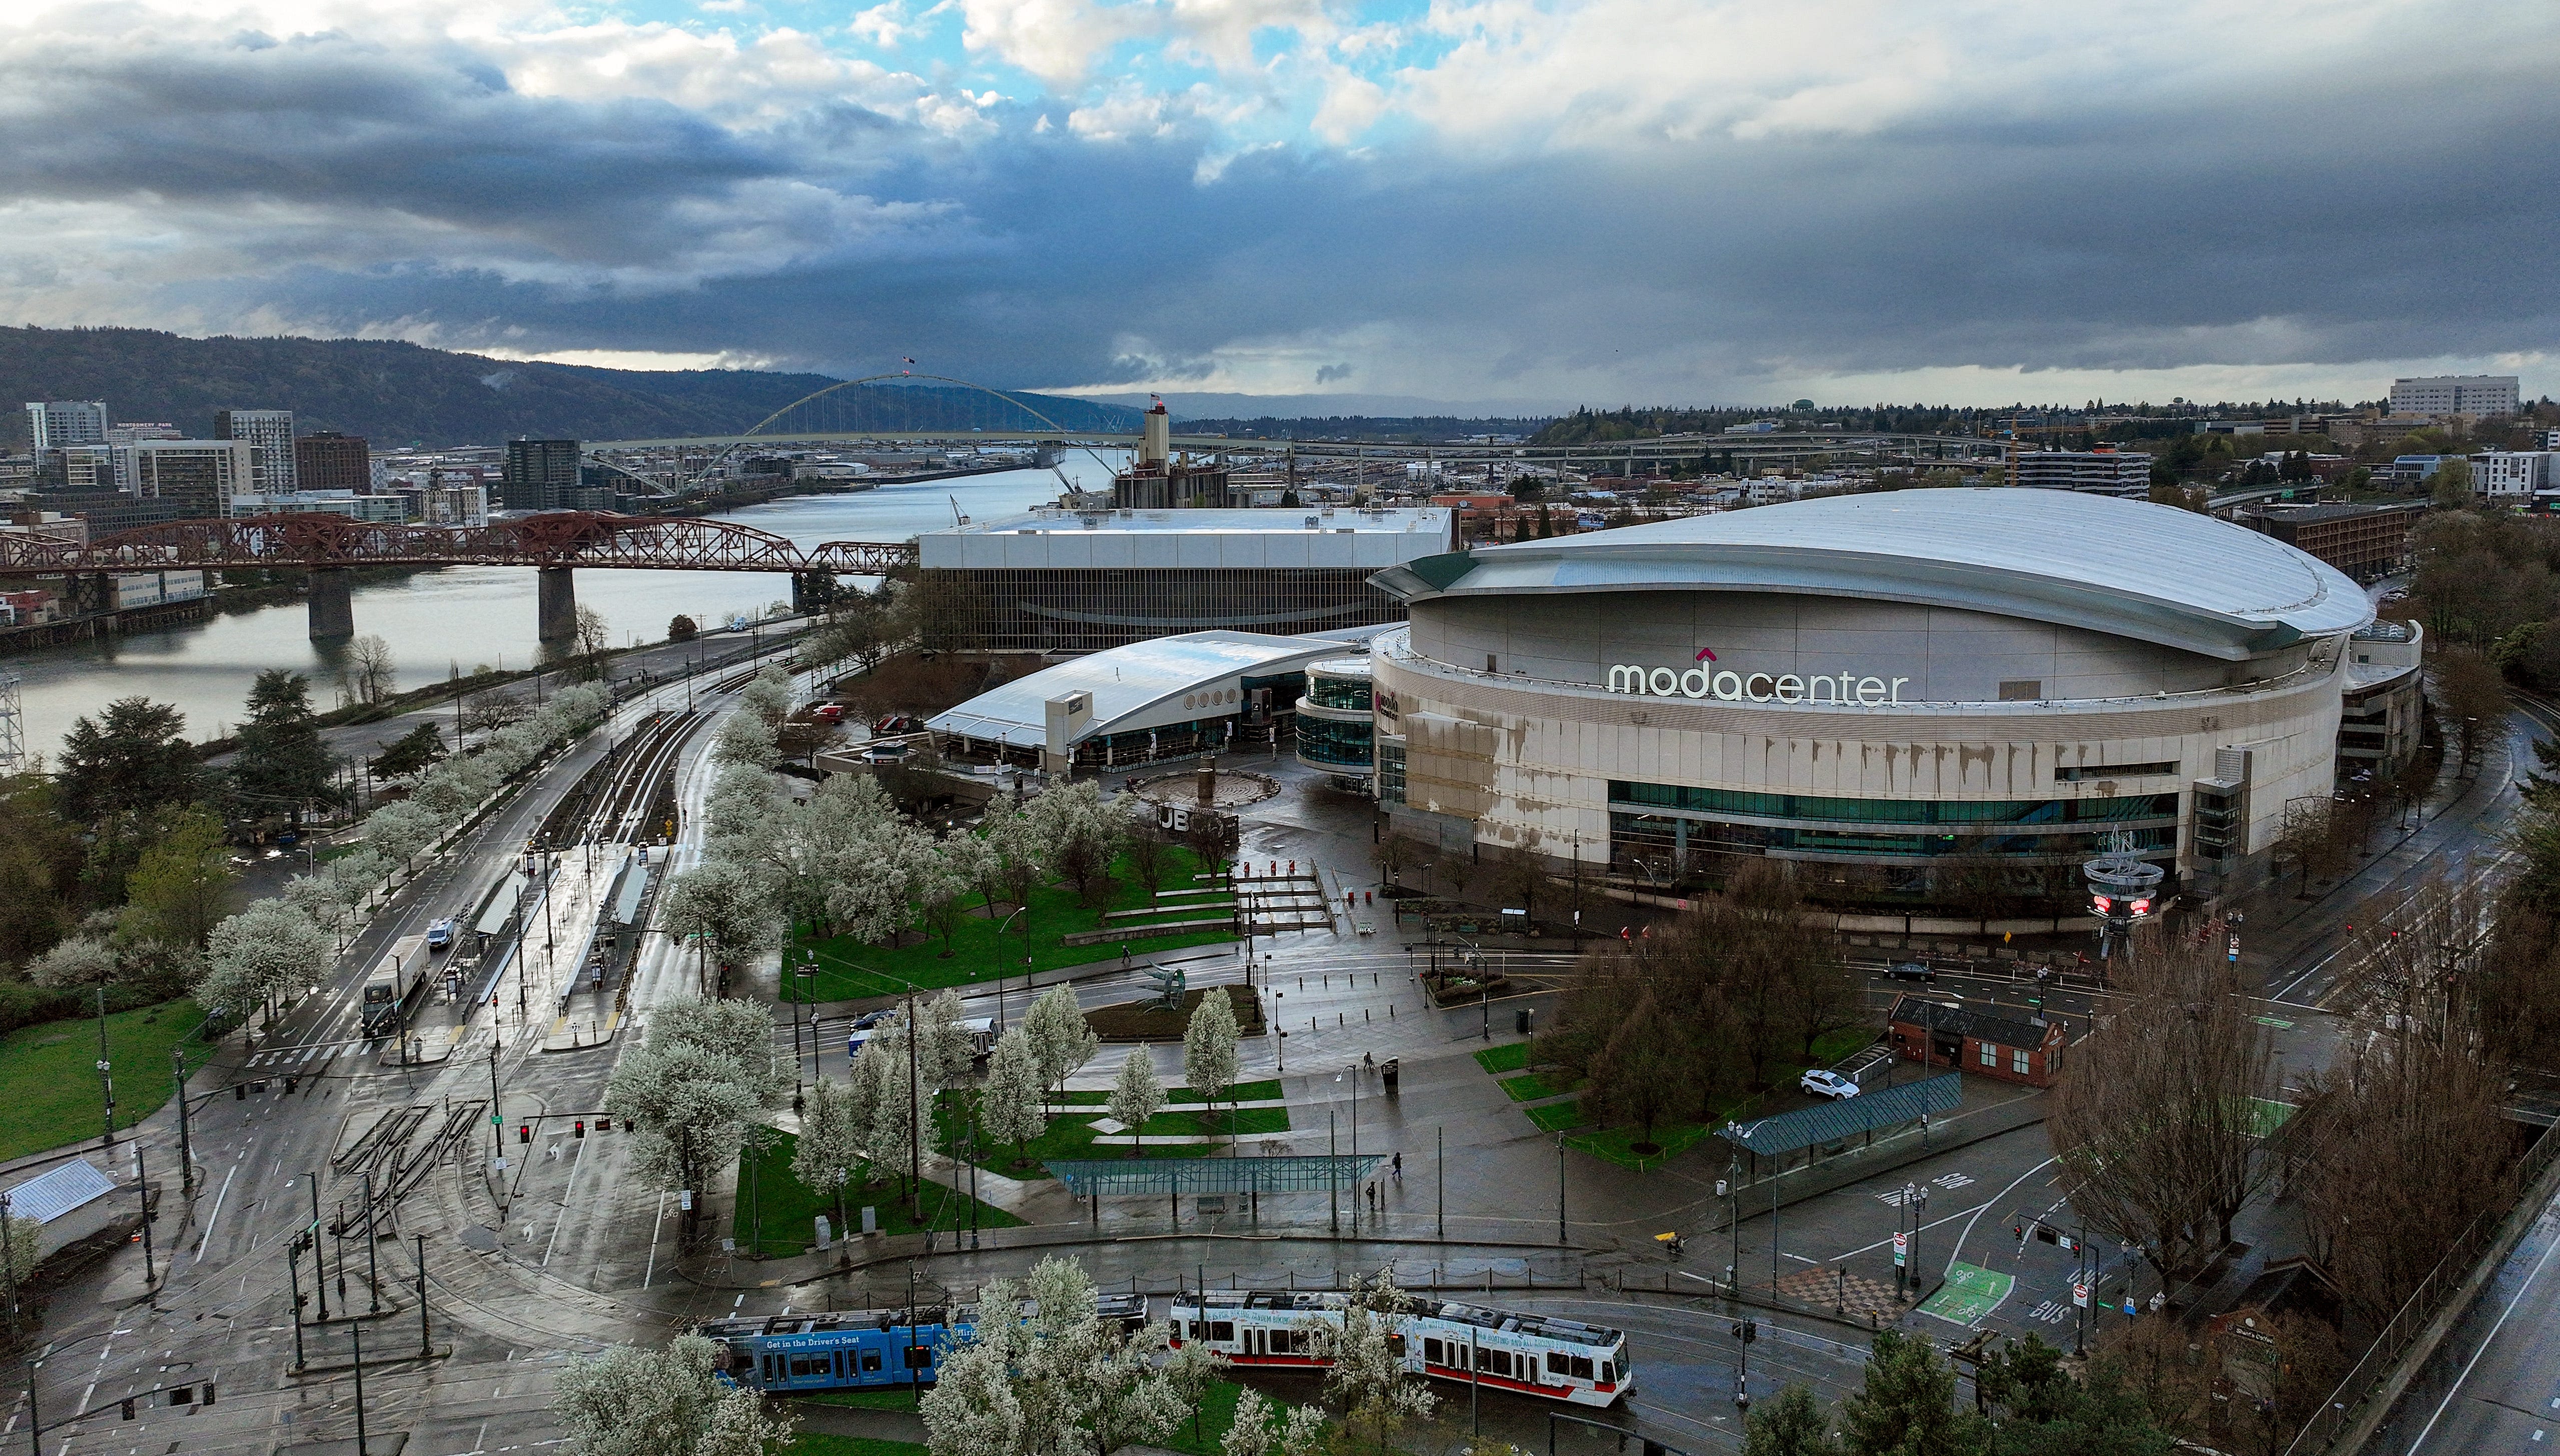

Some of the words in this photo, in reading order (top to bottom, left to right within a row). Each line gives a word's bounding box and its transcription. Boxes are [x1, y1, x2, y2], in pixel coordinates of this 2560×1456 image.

[1381, 694, 1398, 712] moda
[1381, 708, 1399, 721] center
[2029, 1300, 2071, 1324] BUS
[767, 1341, 780, 1349] Get
[782, 1340, 791, 1348] in
[808, 1337, 839, 1346] Driver's
[1488, 1334, 1509, 1345] BOATING
[1511, 1338, 1522, 1347] AND
[1523, 1338, 1532, 1346] ALL
[1535, 1339, 1554, 1349] AROUND
[1556, 1341, 1566, 1350] FUN
[1569, 1343, 1589, 1354] HAVING
